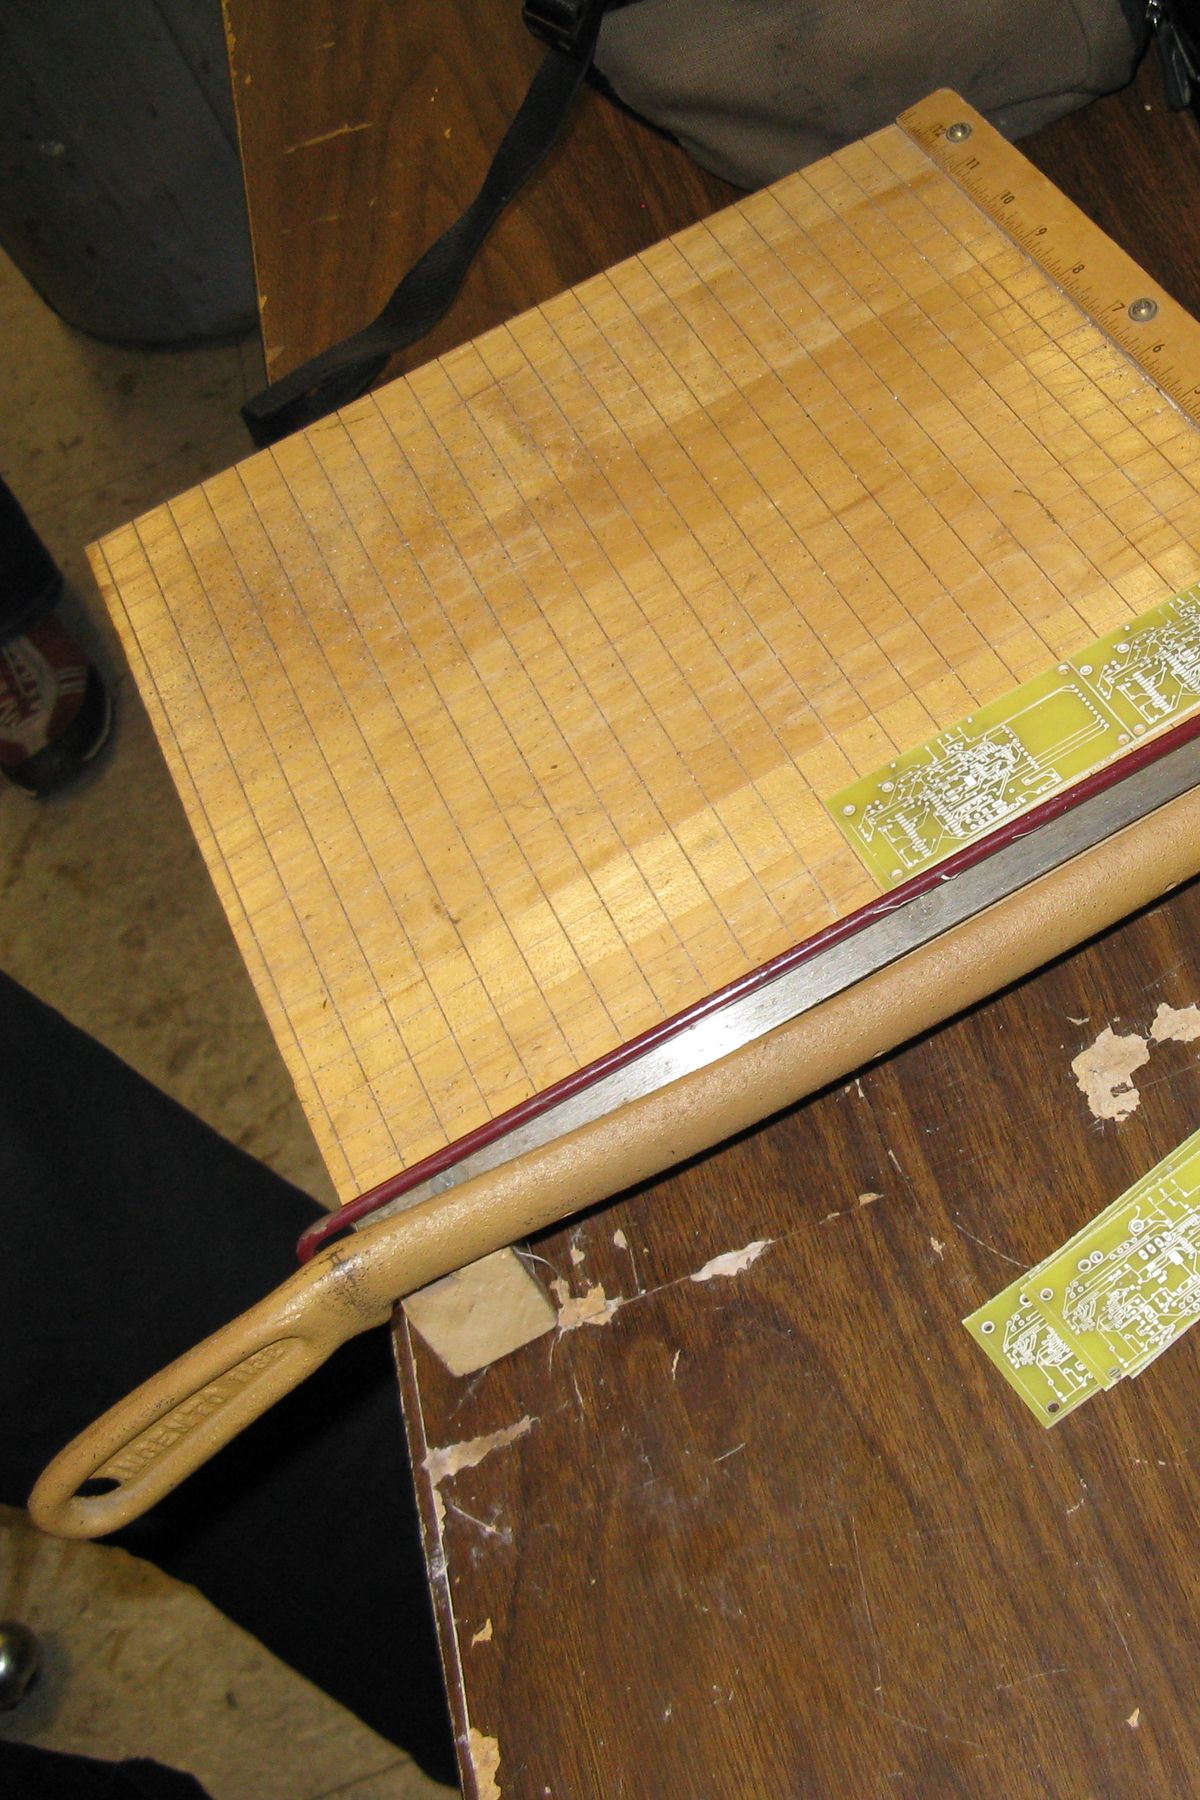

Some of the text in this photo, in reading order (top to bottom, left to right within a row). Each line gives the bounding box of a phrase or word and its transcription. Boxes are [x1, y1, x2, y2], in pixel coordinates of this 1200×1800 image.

[931, 123, 946, 137] 12
[966, 157, 980, 169] 11
[1000, 191, 1015, 205] 10
[1035, 226, 1047, 237] 9
[1072, 263, 1085, 275] 8
[1112, 302, 1125, 312] 7
[1152, 342, 1165, 353] 6
